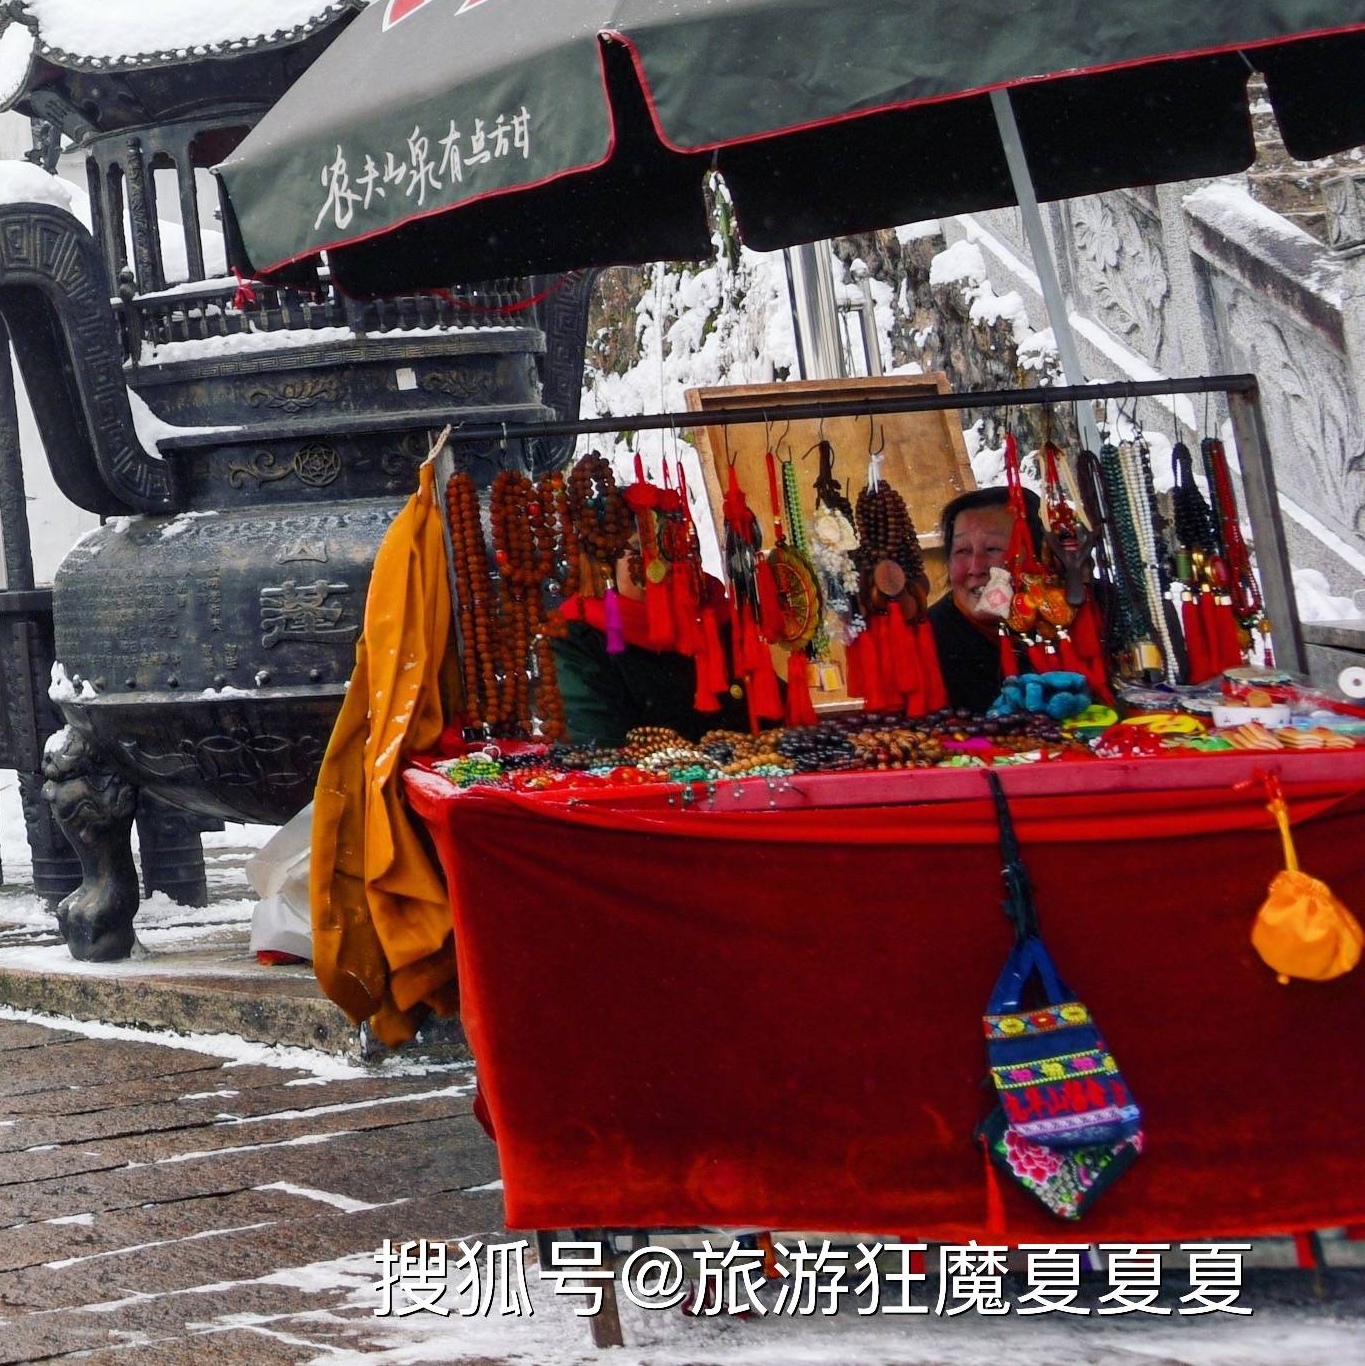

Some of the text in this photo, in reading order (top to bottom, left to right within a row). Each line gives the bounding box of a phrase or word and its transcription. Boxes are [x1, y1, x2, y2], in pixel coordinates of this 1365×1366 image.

[314, 106, 530, 230] 农夫山泉有点甜
